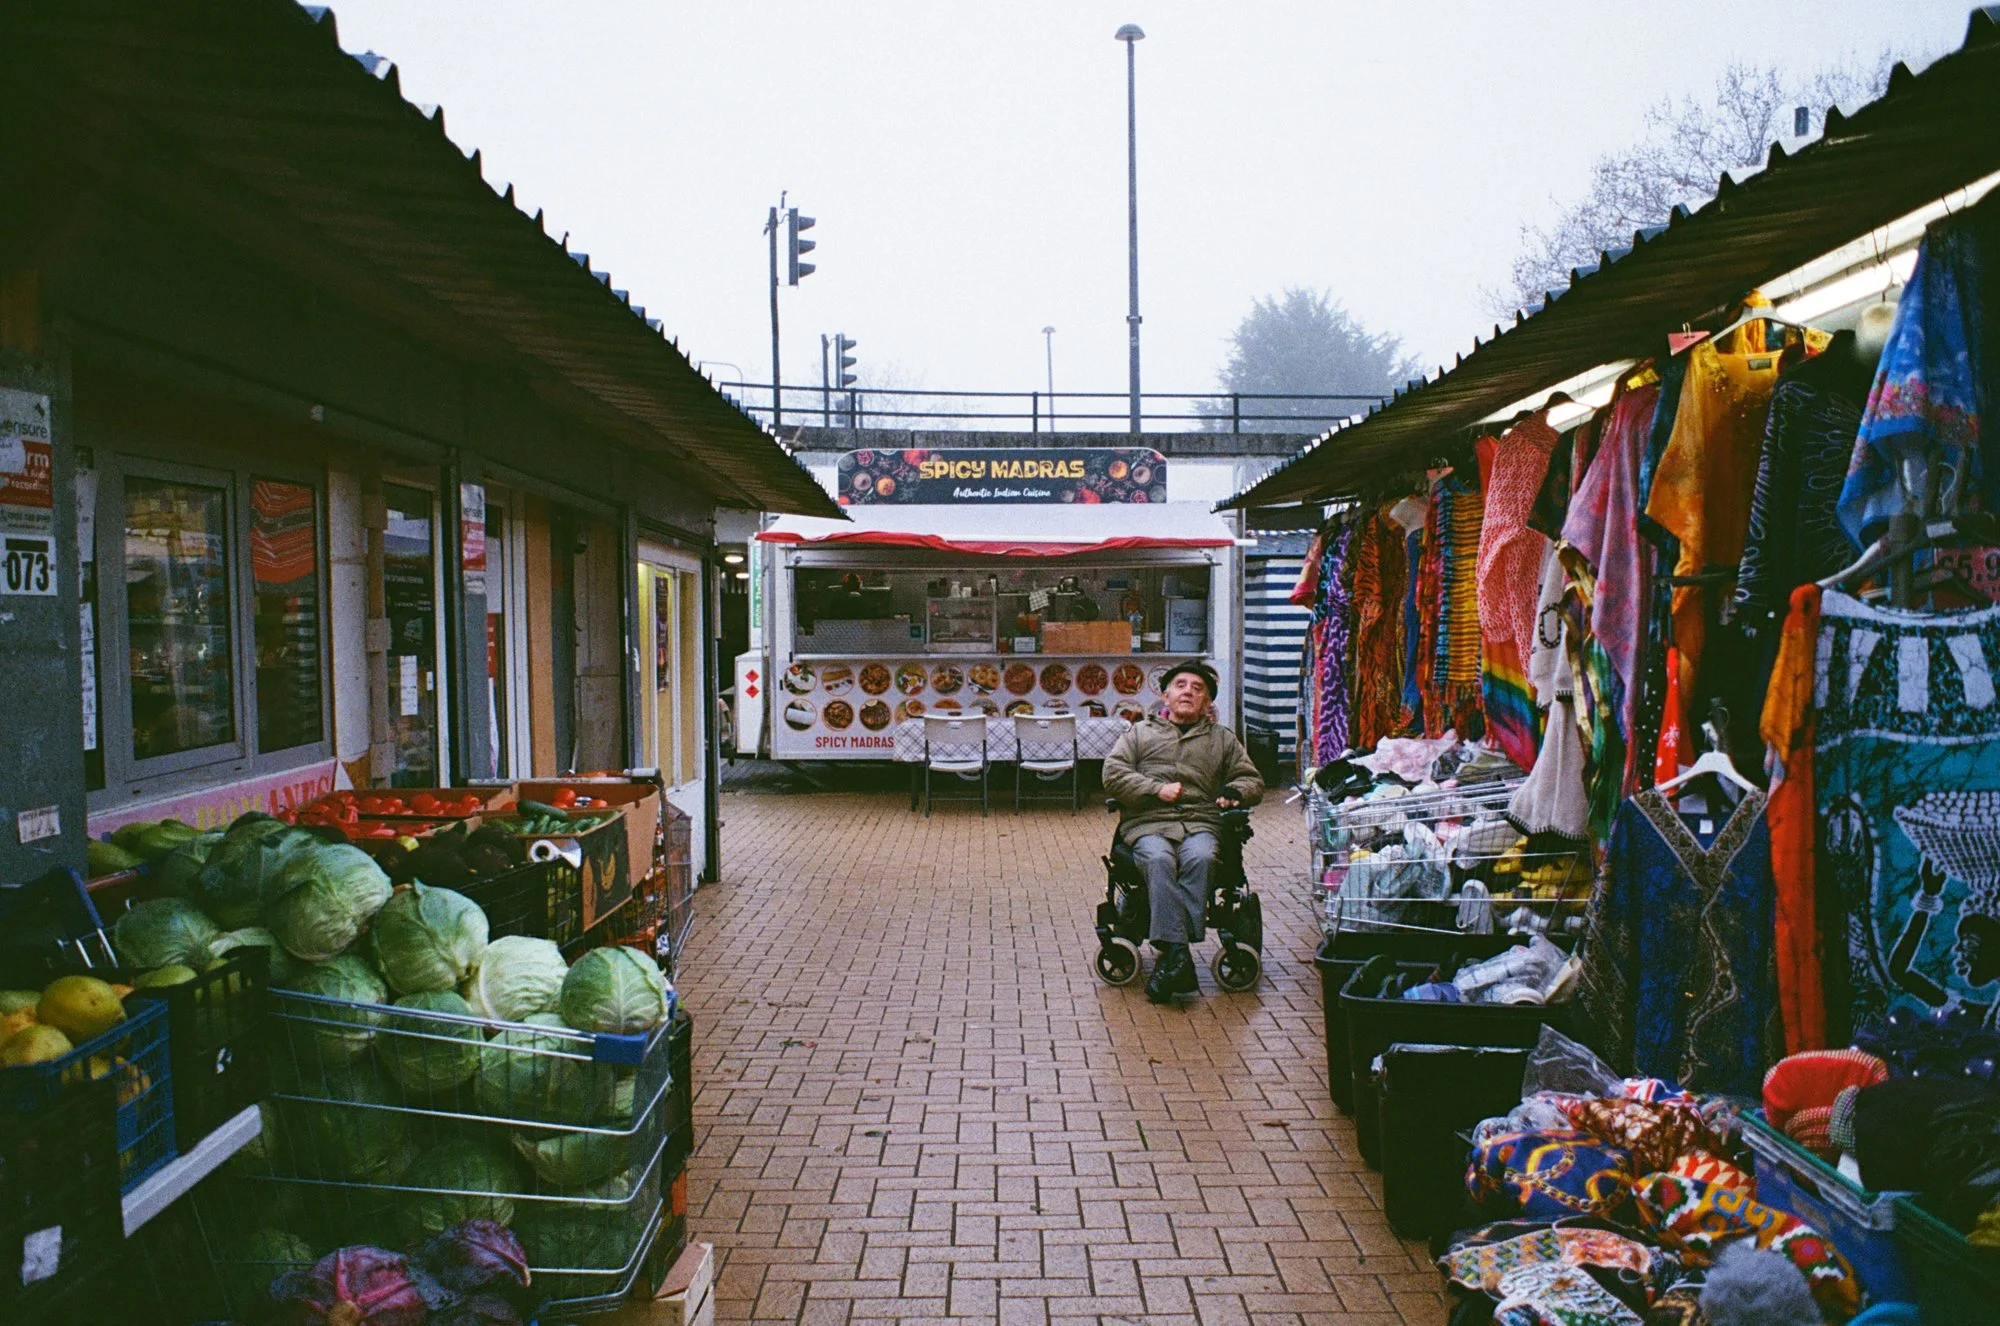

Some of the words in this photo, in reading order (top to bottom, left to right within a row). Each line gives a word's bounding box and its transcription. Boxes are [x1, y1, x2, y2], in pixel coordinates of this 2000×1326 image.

[919, 461, 985, 479] SPICY
[991, 460, 1085, 478] MADRAS
[953, 486, 991, 499] Authentic
[993, 487, 1021, 498] Indian
[1024, 486, 1051, 498] Cuisine
[7, 551, 49, 592] 073
[815, 736, 847, 748] SPICY
[851, 736, 894, 748] MADRAS
